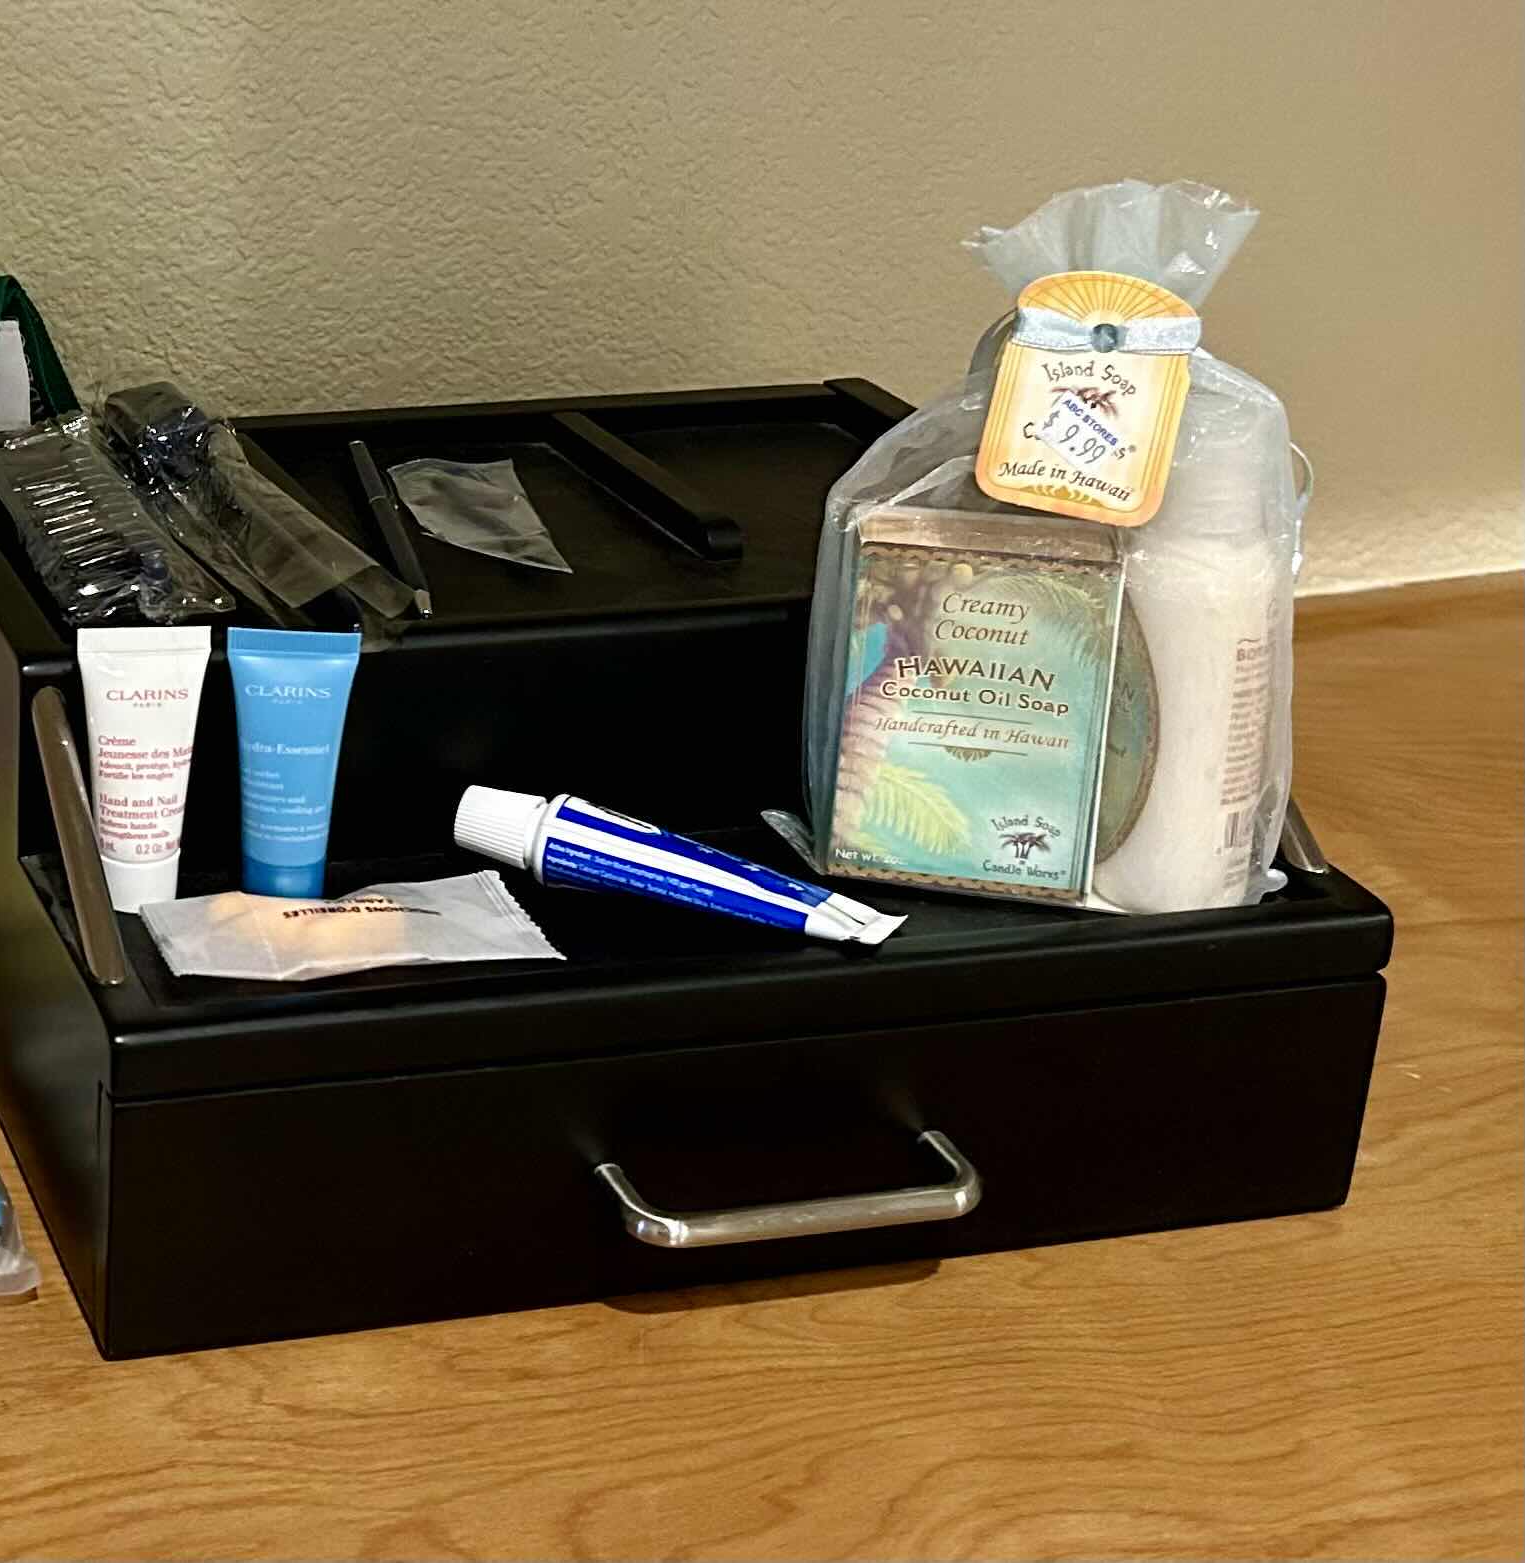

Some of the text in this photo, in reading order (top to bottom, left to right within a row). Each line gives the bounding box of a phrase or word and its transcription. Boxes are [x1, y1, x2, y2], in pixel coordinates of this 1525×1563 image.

[1042, 360, 1137, 397] Island Soap
[1062, 399, 1119, 446] ABC STORES
[997, 459, 1134, 503] Made in Hawaii
[942, 592, 1031, 624] Creamy
[935, 618, 1029, 646] Coconut
[896, 656, 1056, 693] HAWAIIAN
[106, 688, 188, 701] CLARINS
[244, 684, 332, 698] CLARINS
[882, 681, 1070, 717] Coconut Oil Soap
[876, 716, 978, 739] Handcrafted
[983, 727, 1000, 738] in
[98, 747, 148, 759] Jeunesse
[151, 748, 170, 759] des
[99, 792, 128, 807] Hand
[132, 796, 154, 807] and
[99, 804, 157, 819] Treatment
[991, 814, 1061, 838] Island Soap
[982, 859, 1022, 875] Candle
